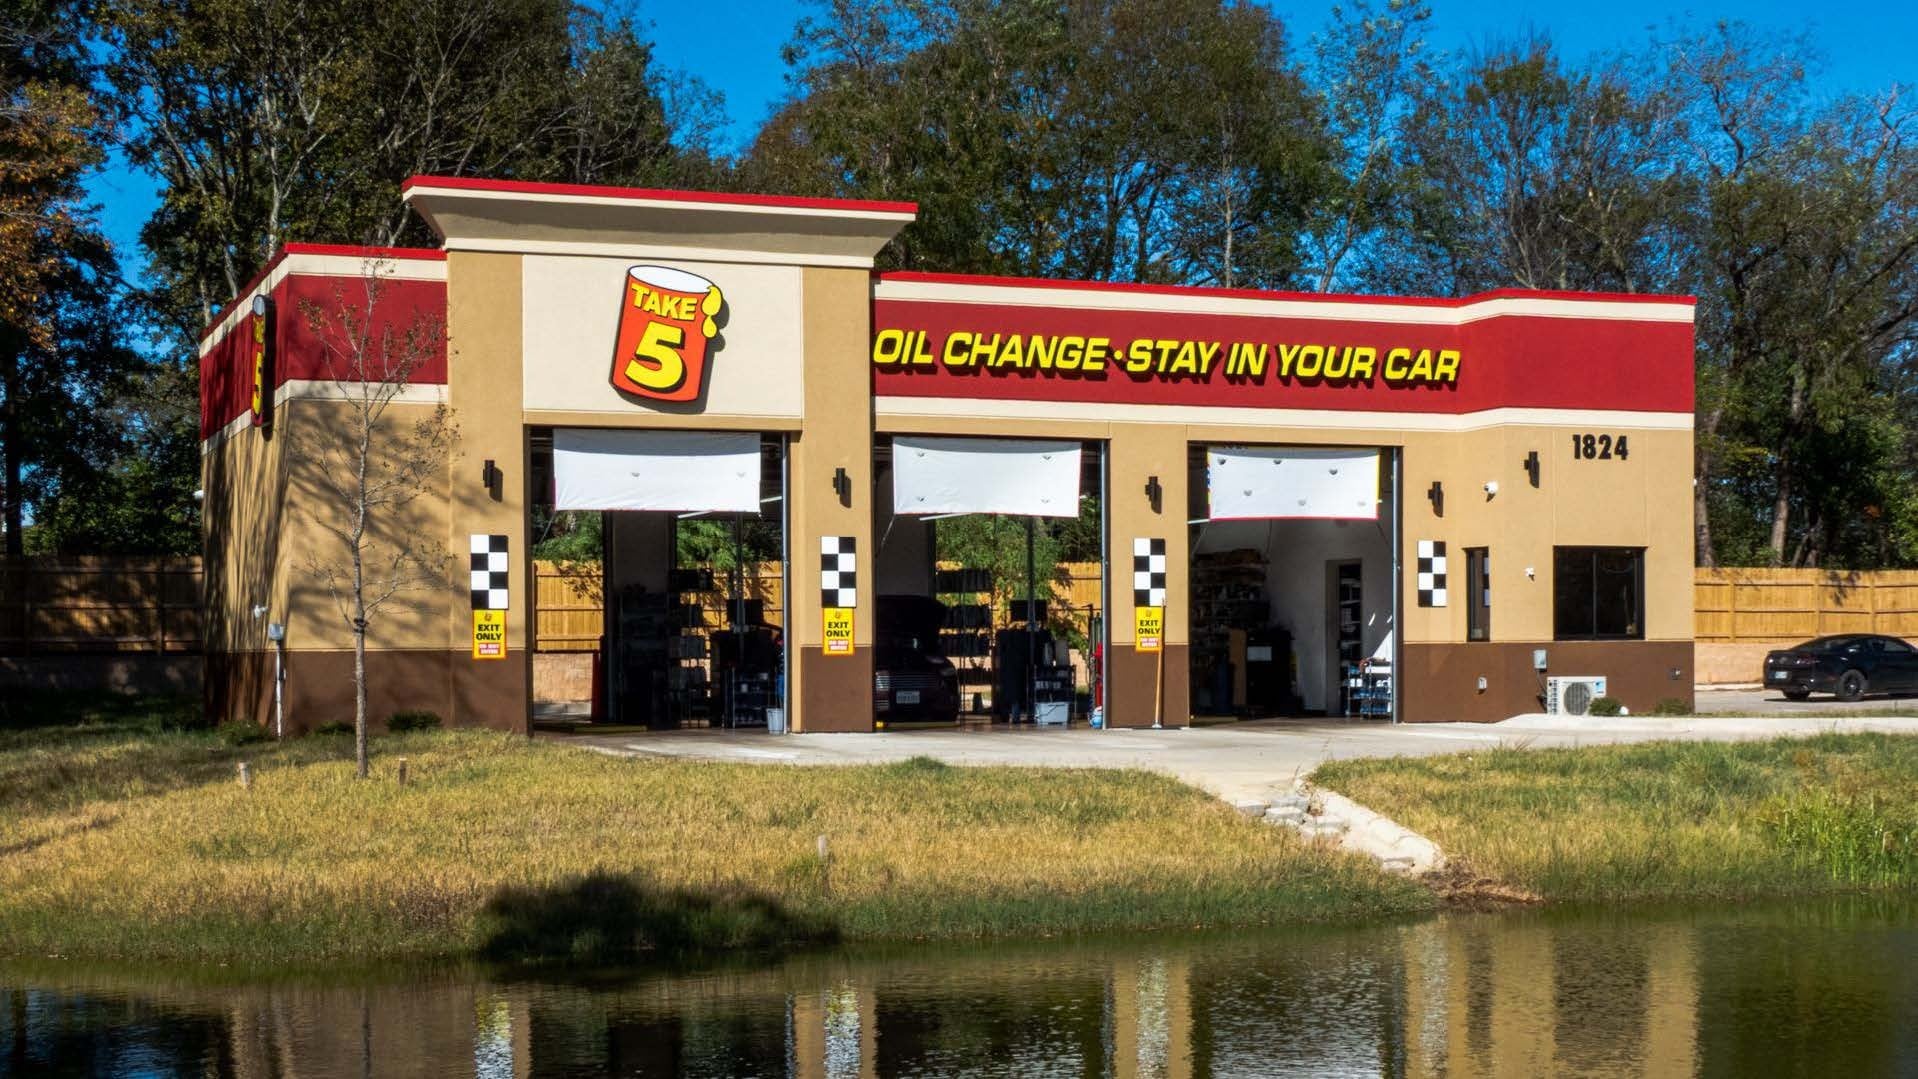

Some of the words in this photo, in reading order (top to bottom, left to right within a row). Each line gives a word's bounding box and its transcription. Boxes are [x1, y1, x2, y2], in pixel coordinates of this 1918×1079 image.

[631, 282, 697, 321] TAKE
[624, 321, 687, 392] 5
[873, 329, 933, 364] OIL
[943, 332, 1110, 371] CHANGE
[1126, 339, 1221, 374] STAY
[1226, 343, 1268, 375] IN
[1279, 344, 1377, 379] YOUR
[1384, 348, 1461, 382] CAR
[1572, 433, 1629, 461] 1824
